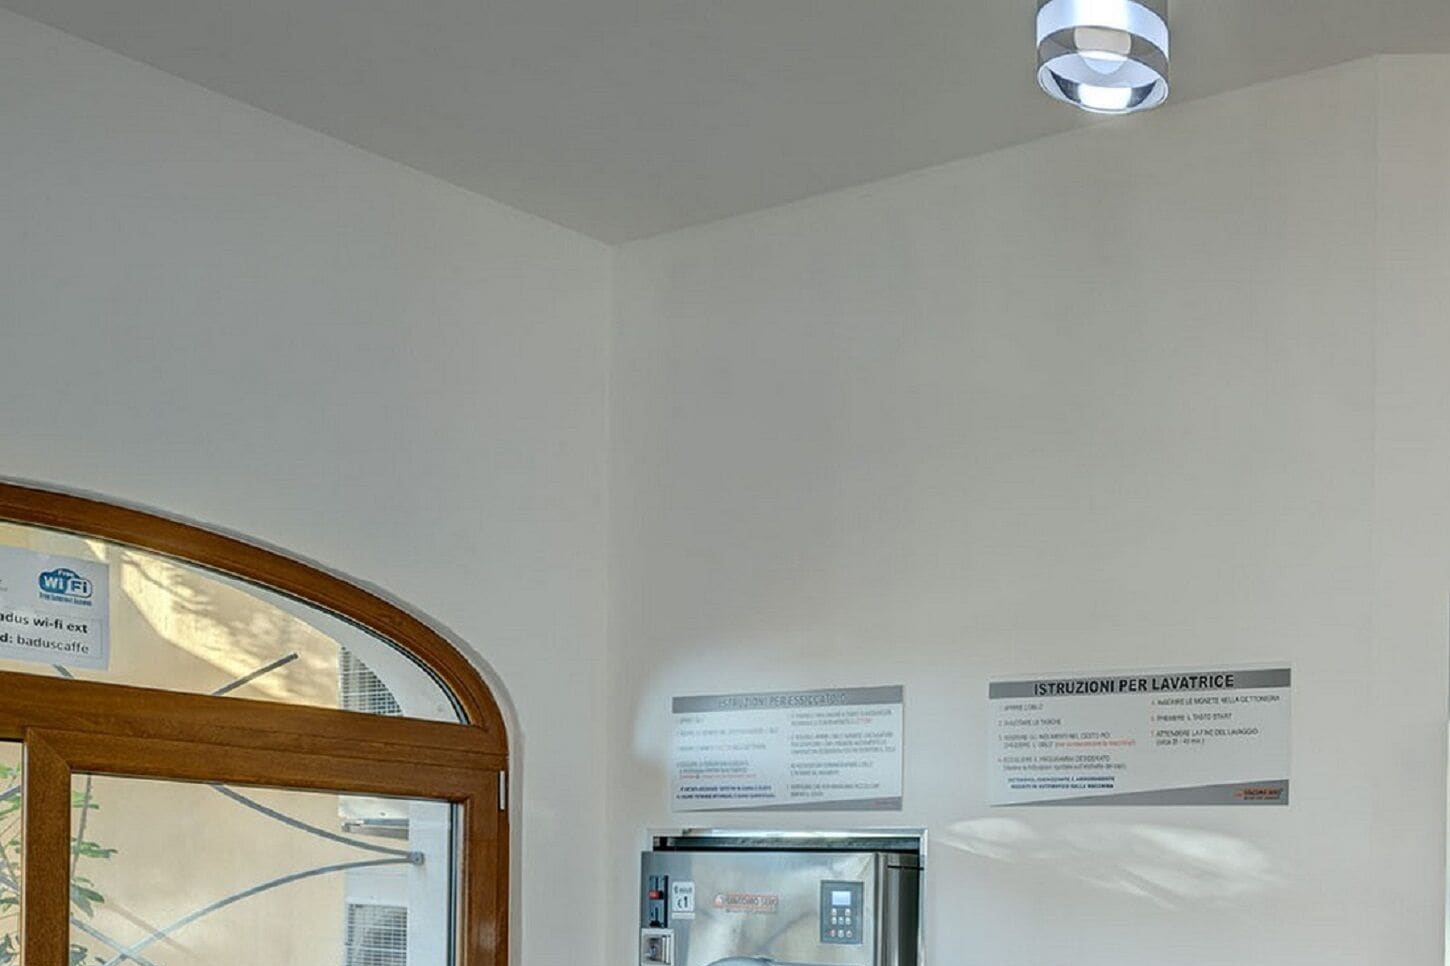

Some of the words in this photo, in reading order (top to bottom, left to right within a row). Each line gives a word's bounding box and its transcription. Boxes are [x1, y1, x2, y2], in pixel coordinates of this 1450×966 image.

[33, 617, 62, 630] wi-fi
[66, 620, 88, 634] ext
[16, 634, 89, 655] baduscaffe
[1034, 680, 1115, 696] ISTRUZIONI
[1118, 679, 1148, 693] PER
[1151, 675, 1234, 691] LAVATRICE
